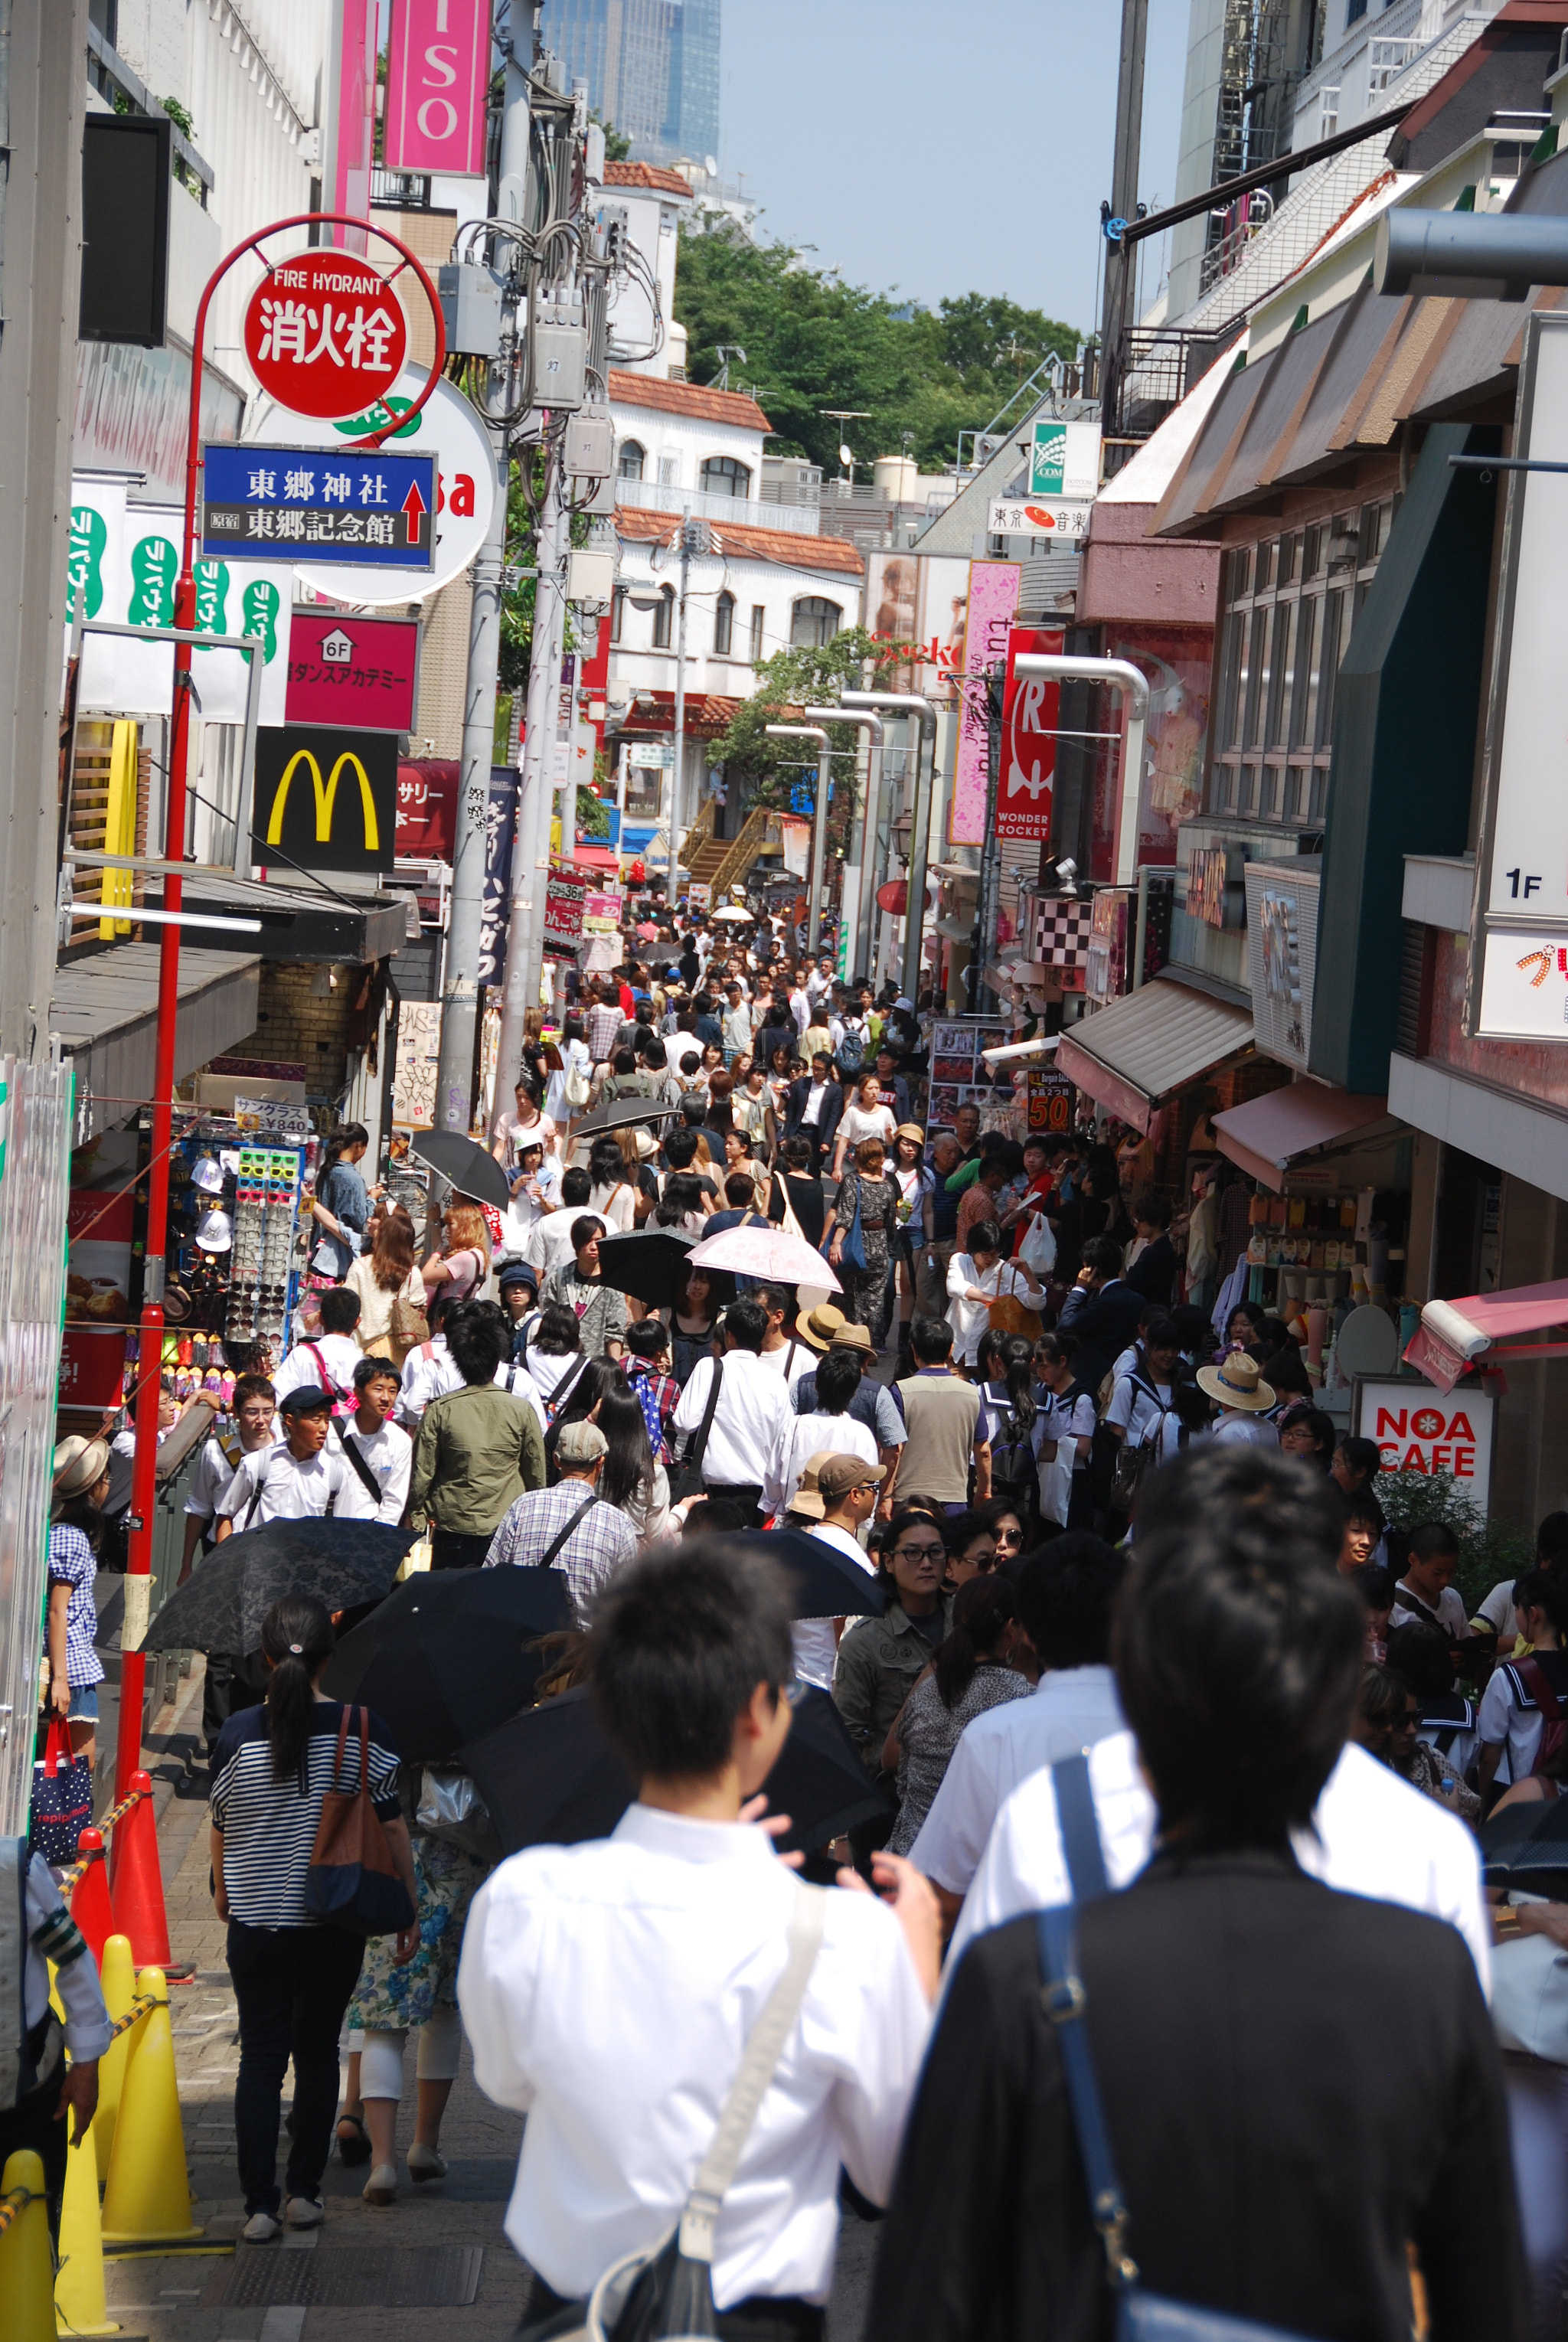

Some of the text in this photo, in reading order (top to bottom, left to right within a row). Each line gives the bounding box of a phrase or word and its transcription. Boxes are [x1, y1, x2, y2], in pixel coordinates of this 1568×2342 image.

[273, 269, 383, 296] FIRE HYDRANT
[257, 298, 397, 372] 消火栓
[246, 468, 388, 505] 東郷神社
[245, 508, 395, 544] 東郷記念館
[993, 508, 1024, 528] 東京
[325, 642, 348, 658] 6F
[998, 812, 1048, 825] WONDER
[998, 825, 1048, 837] ROCKET
[1506, 867, 1542, 899] 1F
[237, 1099, 303, 1120] サングラス
[1029, 1096, 1068, 1126] 50
[1376, 1407, 1476, 1442] NOA
[1377, 1442, 1475, 1477] CAFE
